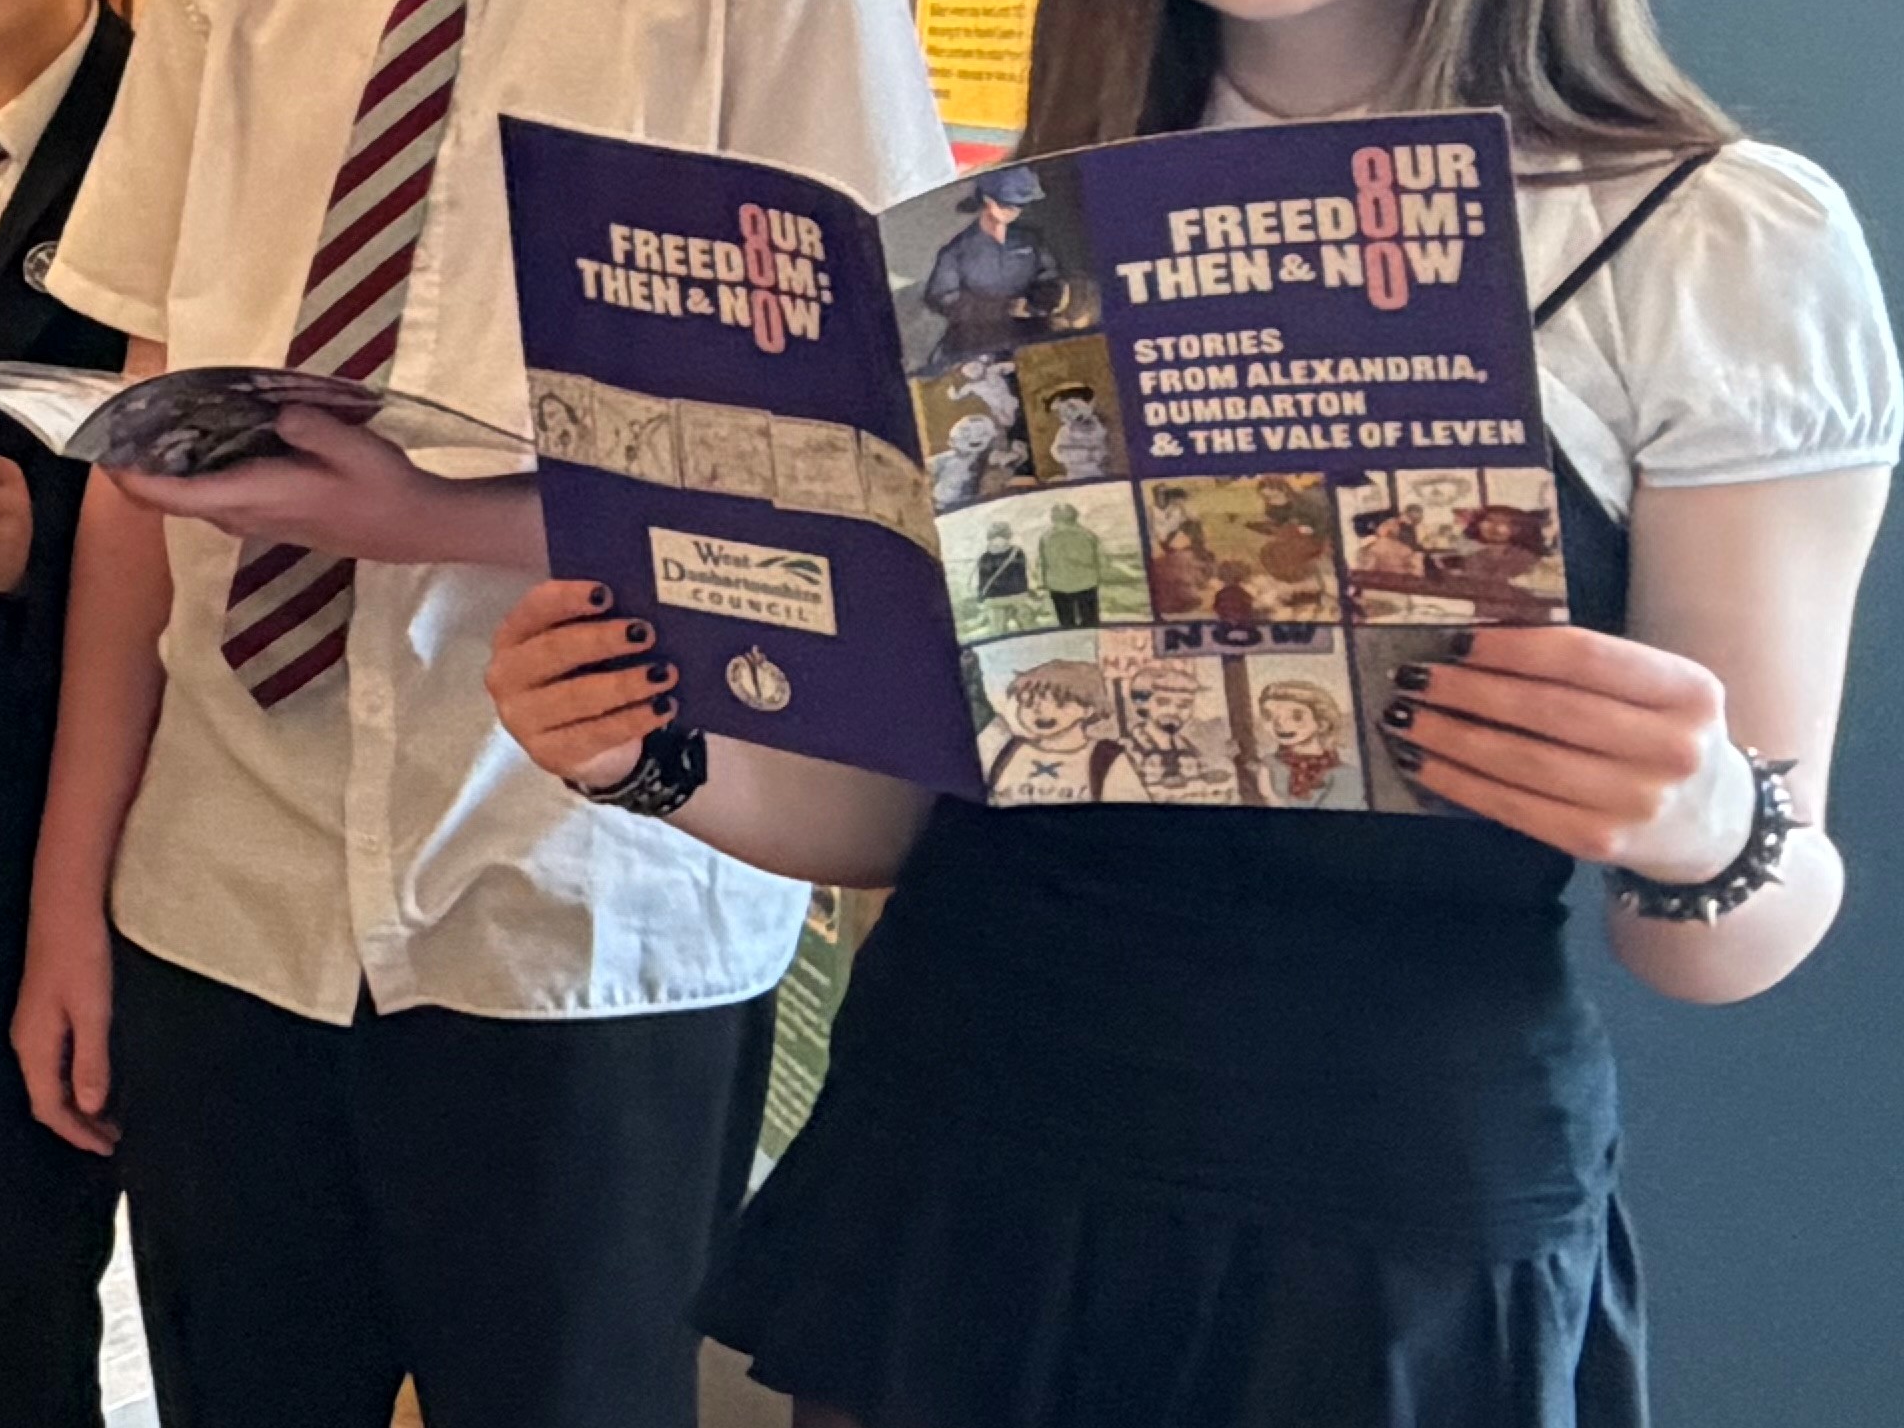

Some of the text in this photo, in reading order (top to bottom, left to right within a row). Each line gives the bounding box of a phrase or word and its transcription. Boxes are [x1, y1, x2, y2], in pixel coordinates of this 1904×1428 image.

[1351, 143, 1480, 190] OUR
[739, 203, 825, 261] OUR
[1168, 191, 1485, 252] FREEDOM:
[609, 222, 834, 304] FREEDOM:
[1116, 239, 1464, 310] THEN & NOW
[575, 257, 821, 354] THEN & NOW
[1133, 328, 1283, 363] STORIES
[1139, 354, 1488, 395] FROM ALEXANDRIA,
[1144, 391, 1366, 427] DUMBARTON
[1150, 419, 1525, 457] & THE VALE OF LEVEN
[692, 588, 809, 622] COUNCIL
[1165, 623, 1317, 653] NOW
